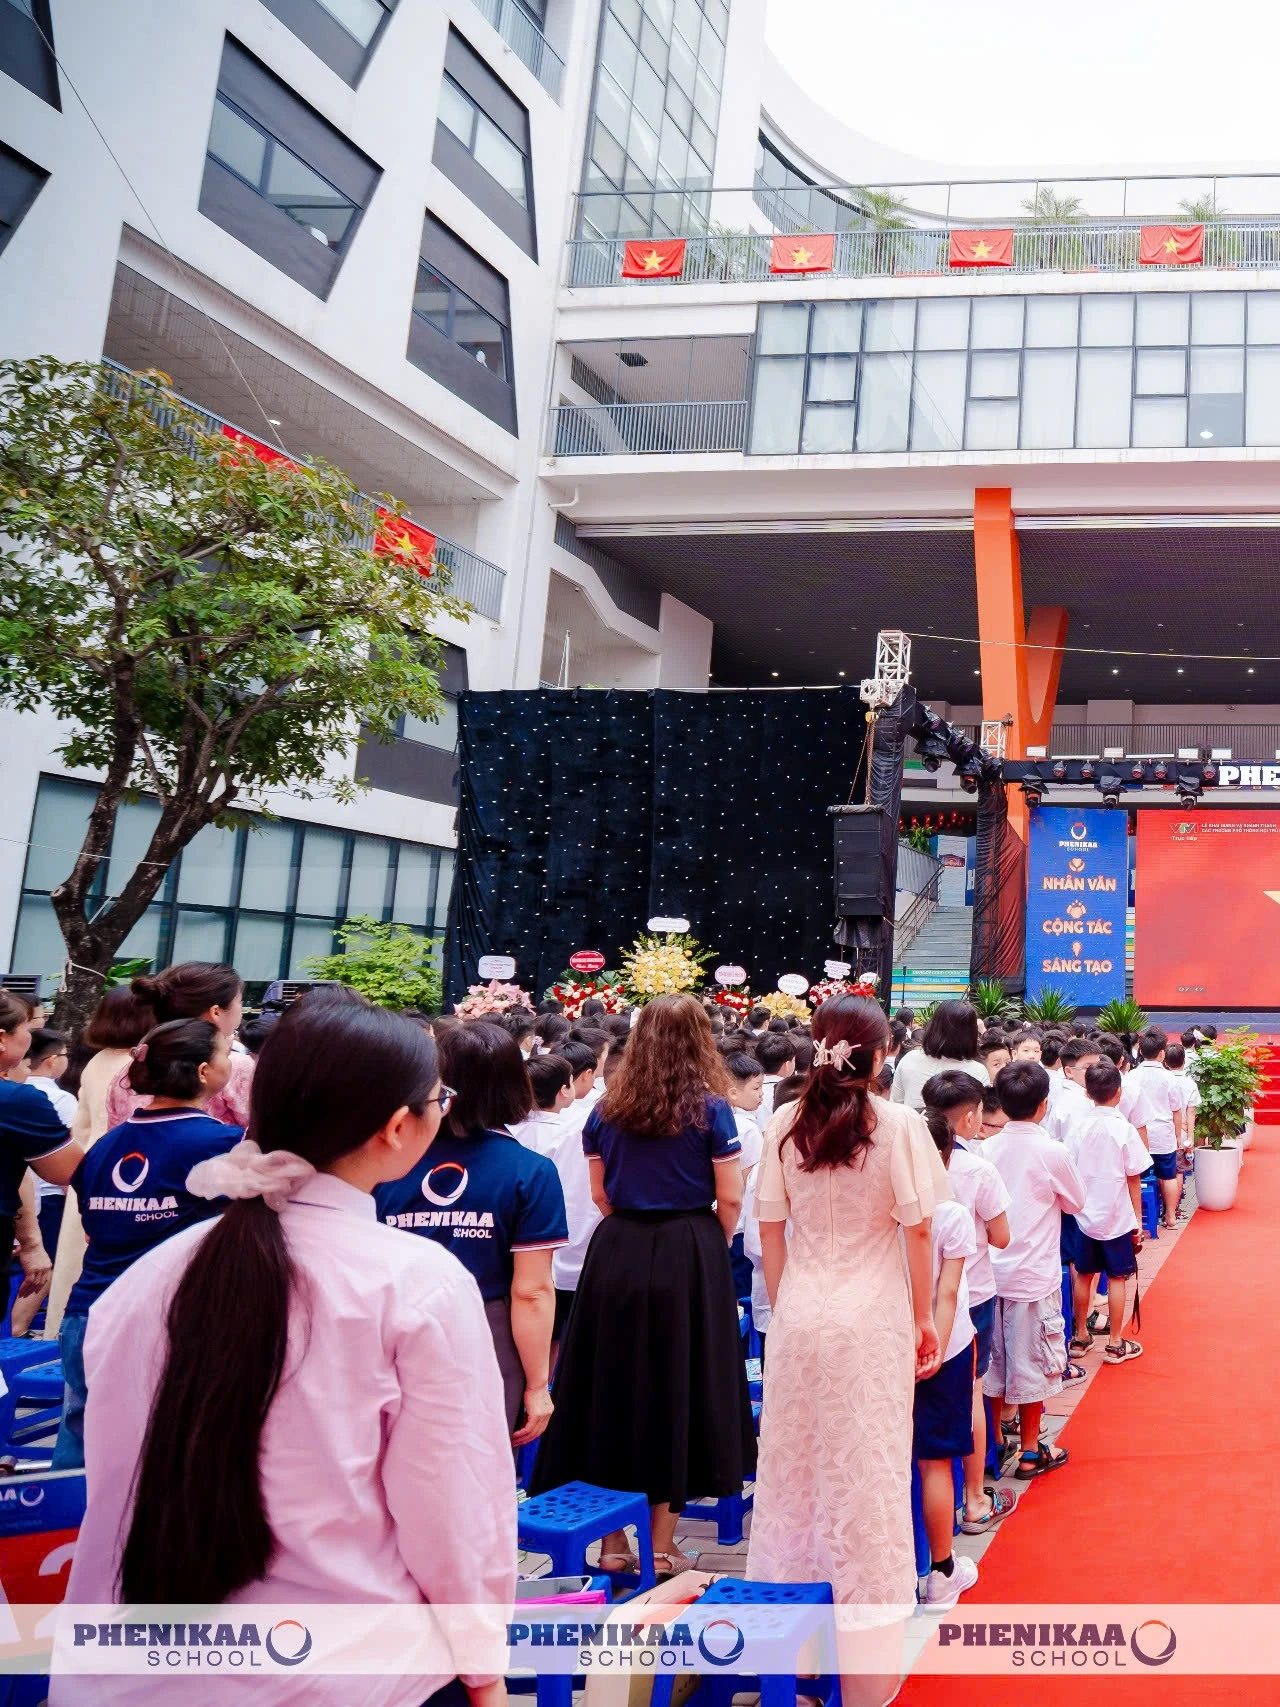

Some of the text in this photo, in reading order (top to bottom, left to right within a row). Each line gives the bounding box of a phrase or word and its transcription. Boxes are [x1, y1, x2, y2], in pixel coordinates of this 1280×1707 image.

[1043, 875, 1117, 892] NHÂN VĂN
[1042, 917, 1113, 936] CỘNG TÁC
[1042, 957, 1113, 976] SÁNG TẠO
[88, 1196, 178, 1211] HENIKAA
[134, 1211, 178, 1222] SCHOOL
